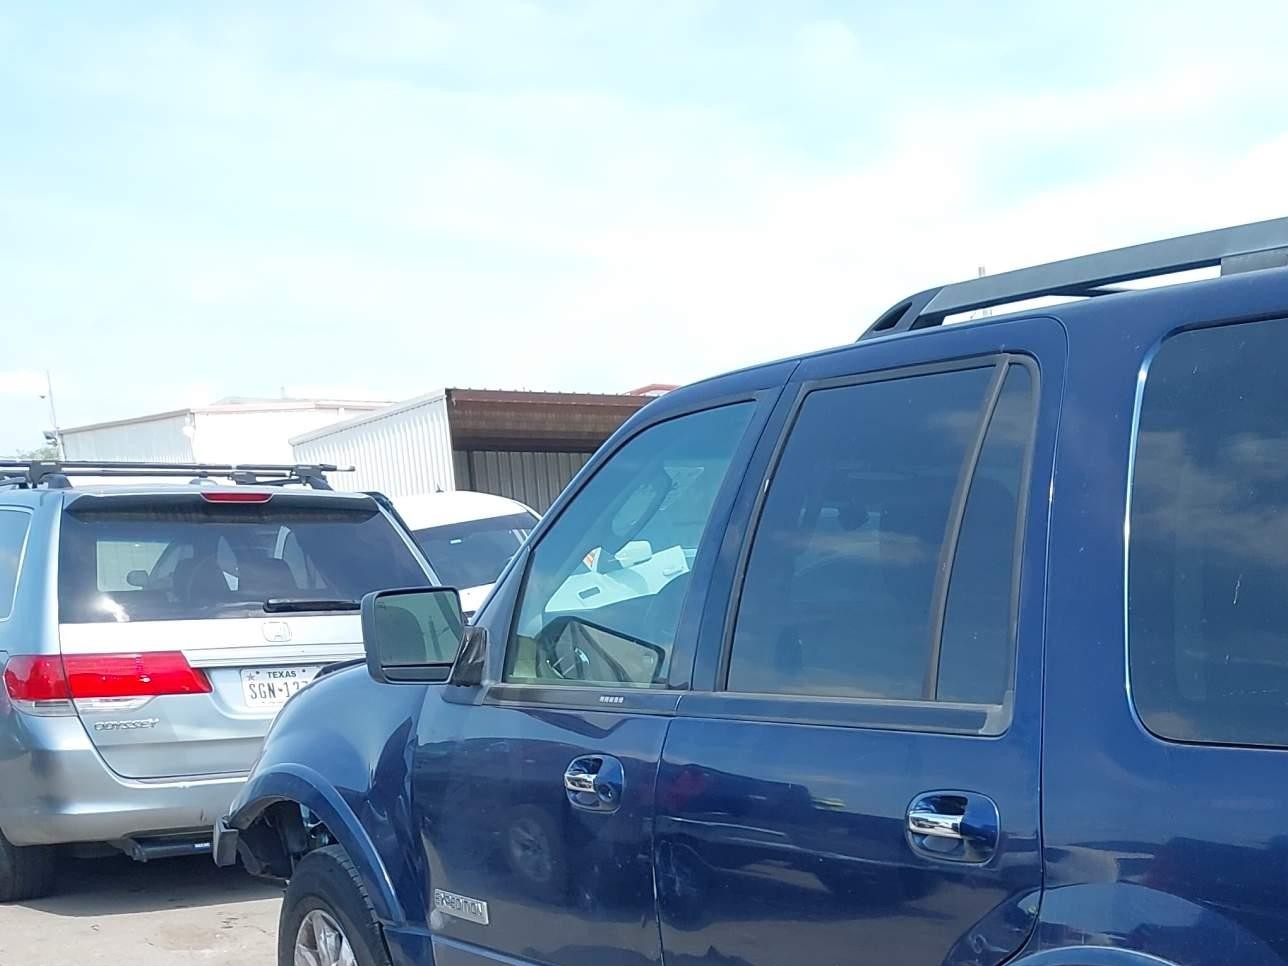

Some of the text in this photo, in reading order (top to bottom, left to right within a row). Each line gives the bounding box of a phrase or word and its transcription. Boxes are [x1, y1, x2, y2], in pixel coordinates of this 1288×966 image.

[267, 670, 297, 679] TEXAS
[94, 718, 160, 731] ODYSSEY
[435, 891, 484, 915] EXPEDITION
